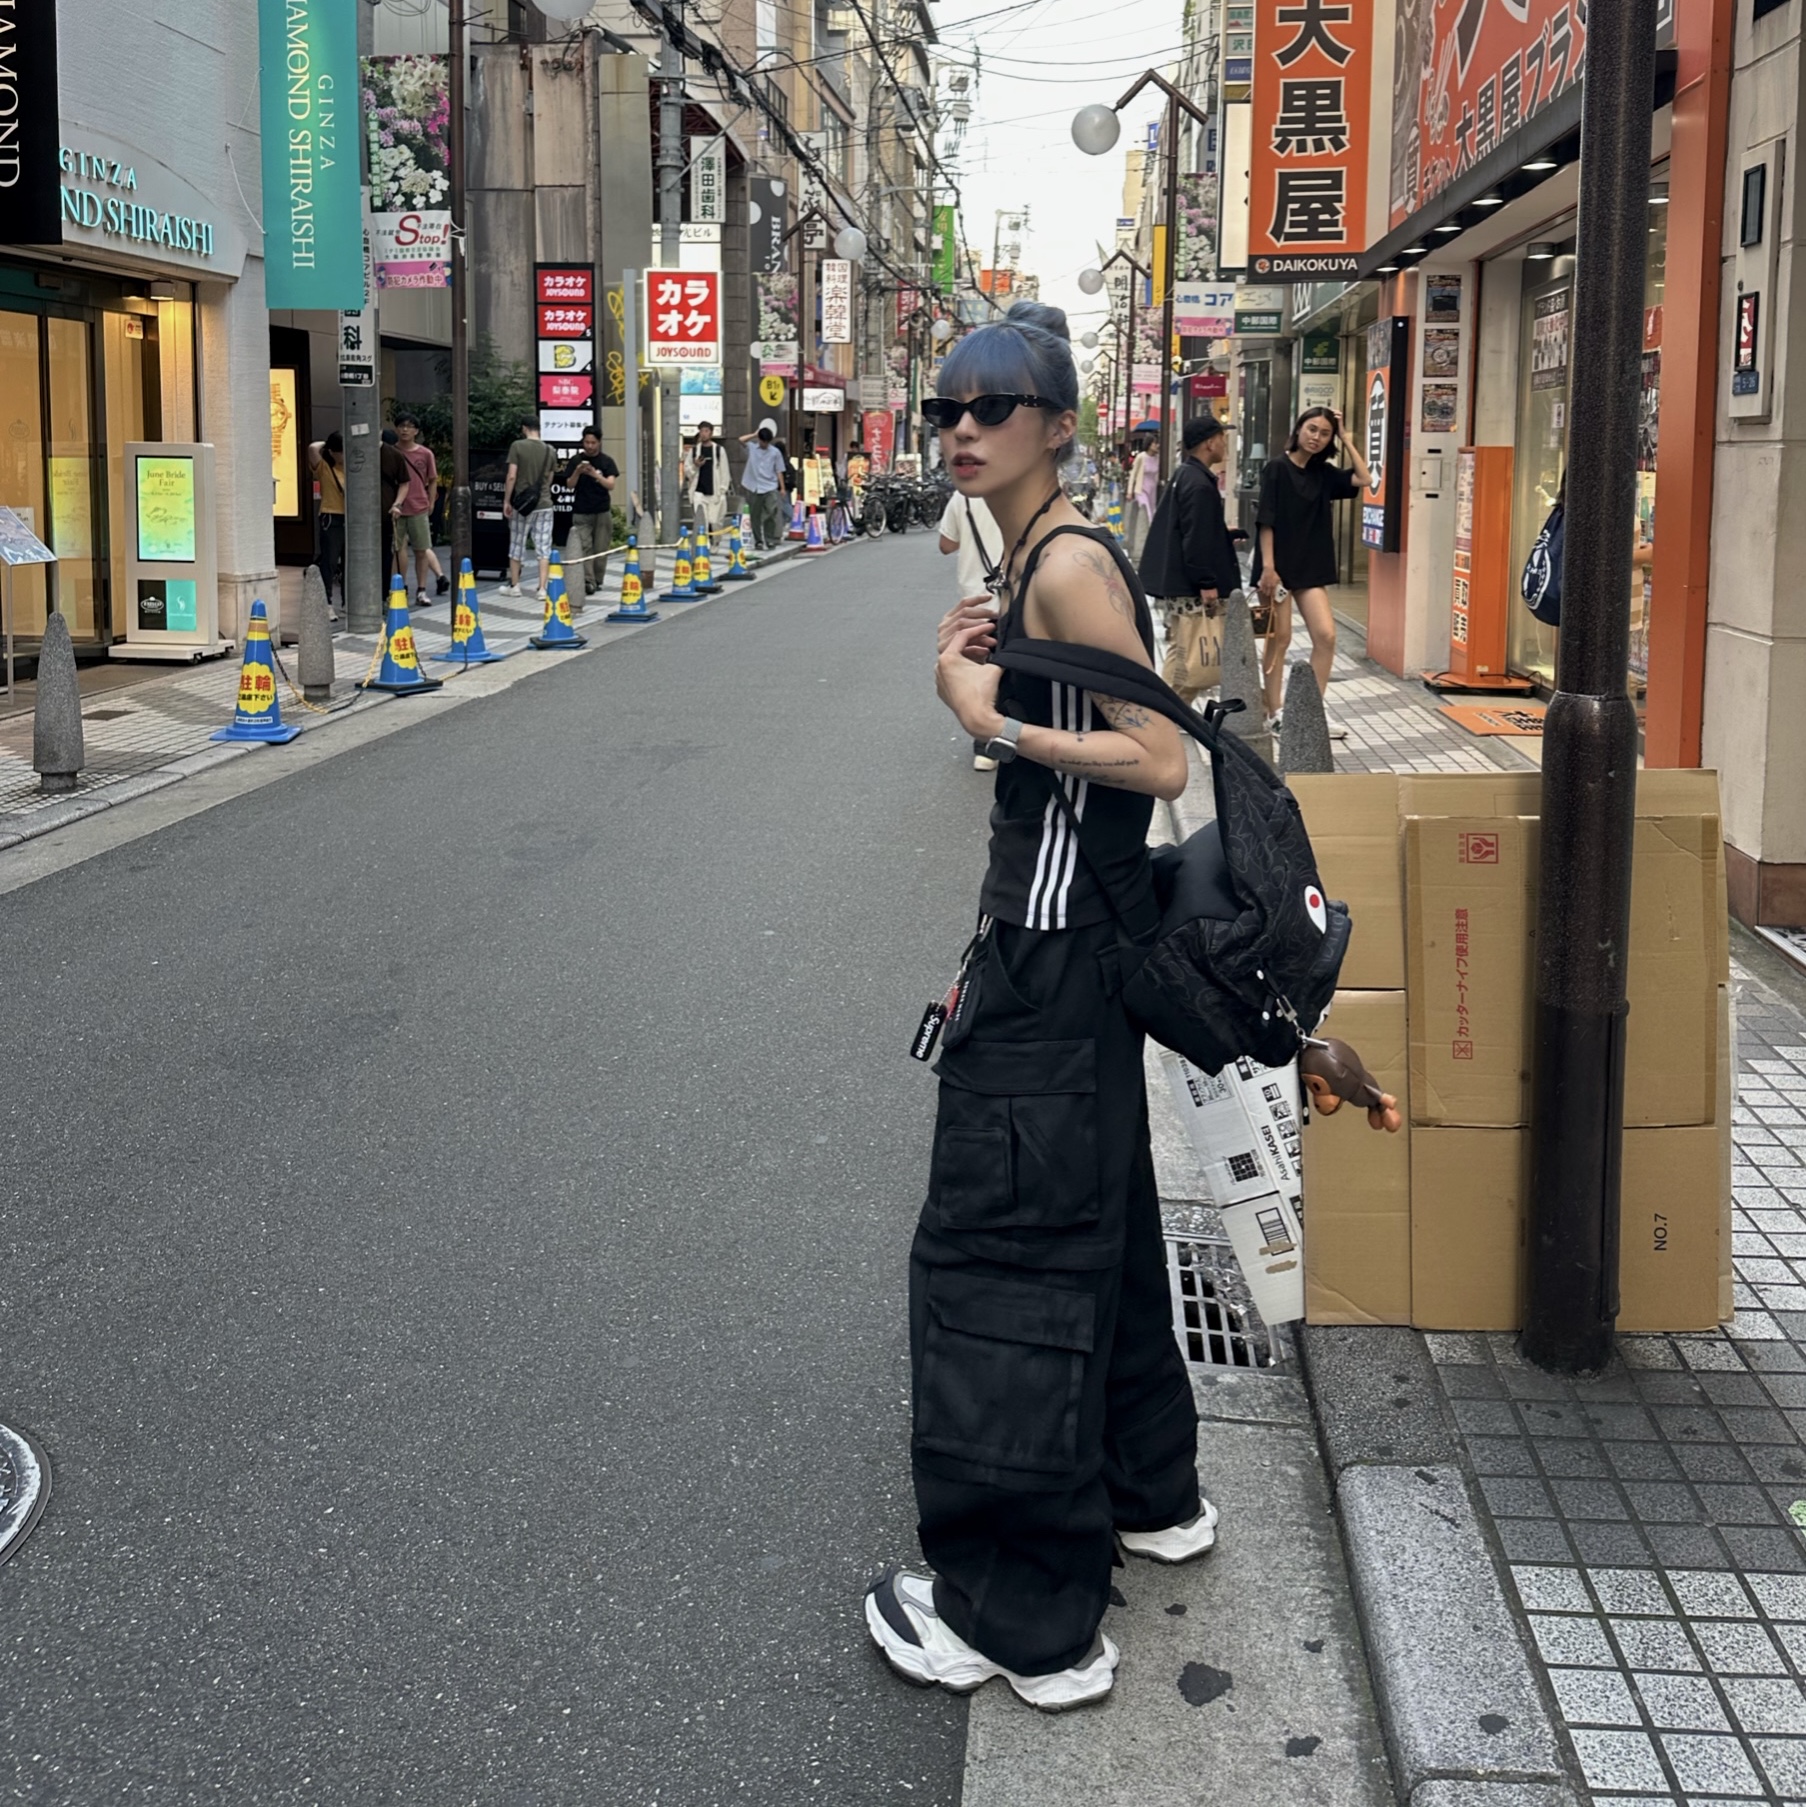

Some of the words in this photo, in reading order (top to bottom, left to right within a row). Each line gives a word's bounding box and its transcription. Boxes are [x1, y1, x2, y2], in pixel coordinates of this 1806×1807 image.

[318, 74, 336, 170] GINZA
[1266, 0, 1355, 249] 大黒屋
[59, 147, 138, 191] GINZA
[288, 129, 315, 270] SHIRAISHI
[104, 197, 214, 256] SHIRAISHI
[394, 214, 450, 247] Stop!
[1273, 259, 1358, 273] DAIKOKUYA
[544, 276, 587, 288] カラオケ
[545, 289, 585, 297] JOYSOUND
[656, 279, 710, 307] カラ
[1204, 293, 1234, 307] コア
[544, 310, 587, 321] カラオケ
[546, 323, 586, 331] JOYSOUND
[656, 310, 711, 337] オケ
[586, 329, 592, 337] 5
[656, 347, 712, 358] JOYSOUND
[147, 470, 164, 480] June
[165, 470, 186, 479] Bride
[159, 479, 175, 487] Fair
[1454, 907, 1470, 1038] カッターナイフ使用注意
[915, 1013, 941, 1059] Supreme
[1653, 1212, 1668, 1252] NO.7
